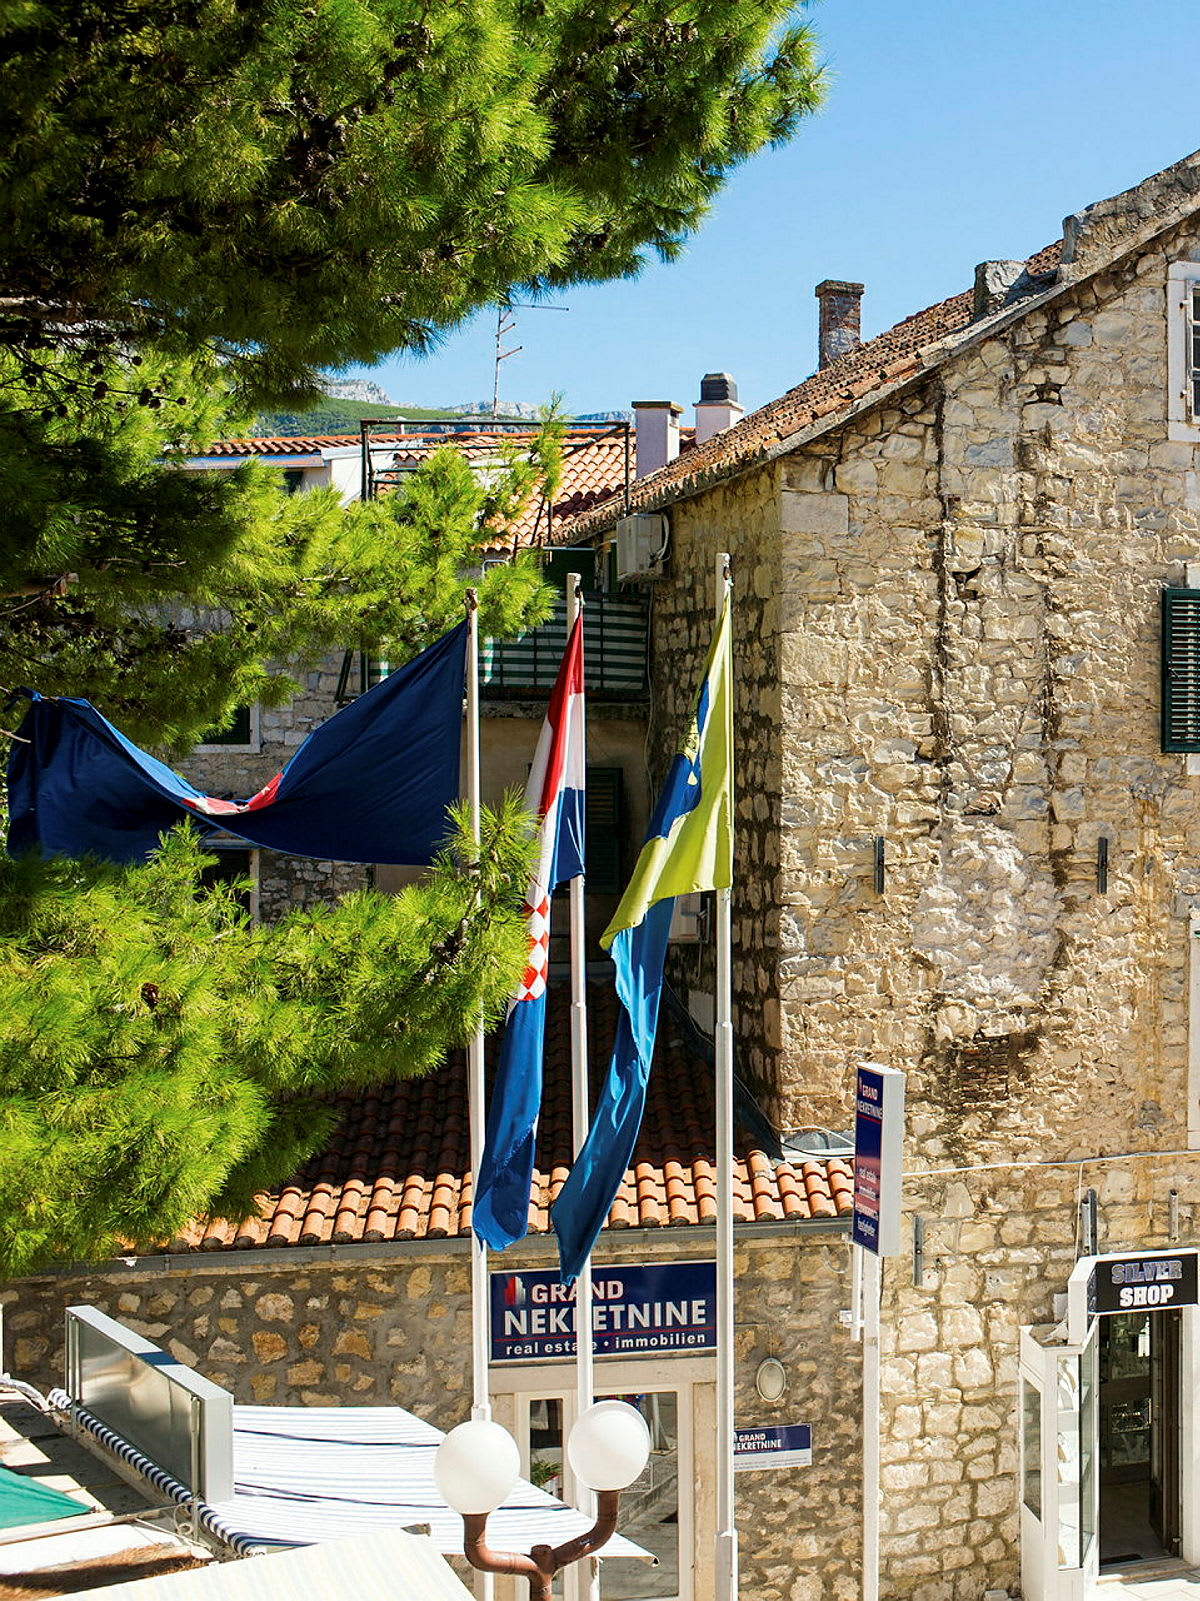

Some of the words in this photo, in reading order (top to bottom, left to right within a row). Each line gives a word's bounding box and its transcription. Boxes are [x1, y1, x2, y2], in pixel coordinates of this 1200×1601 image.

[1111, 1260, 1183, 1284] SILVER
[1120, 1284, 1174, 1307] SHOP
[504, 1299, 706, 1336] NEKETNINE
[506, 1341, 538, 1355] real
[544, 1339, 598, 1353] estae
[615, 1333, 705, 1349] immobilien
[738, 1433, 766, 1442] GRAND
